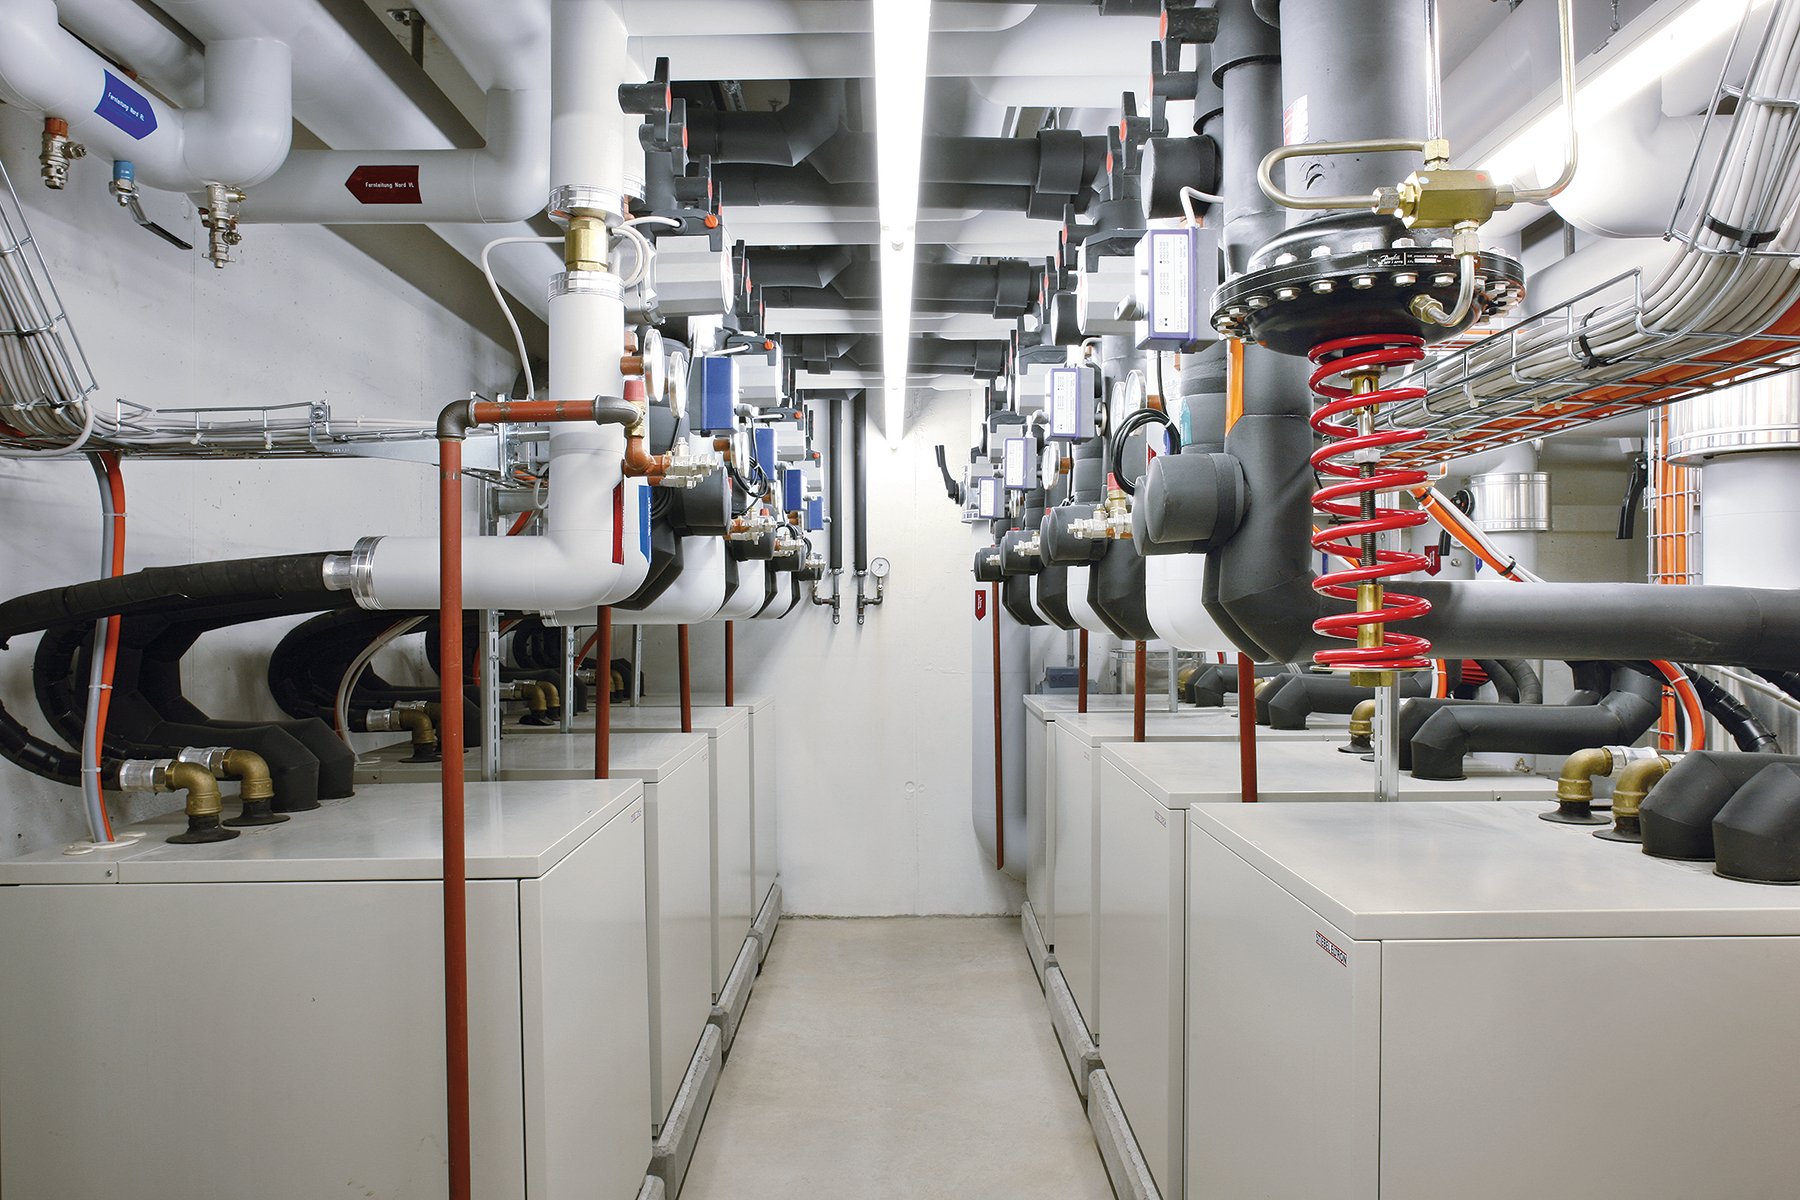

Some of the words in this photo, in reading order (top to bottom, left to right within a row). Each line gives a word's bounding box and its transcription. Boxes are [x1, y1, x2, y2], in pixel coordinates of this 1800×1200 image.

[108, 91, 129, 112] Fernleitung
[130, 106, 140, 118] Nord
[365, 181, 393, 189] Fernleitung
[1315, 932, 1331, 953] STIEBEL
[1330, 944, 1348, 965] ELTRON
